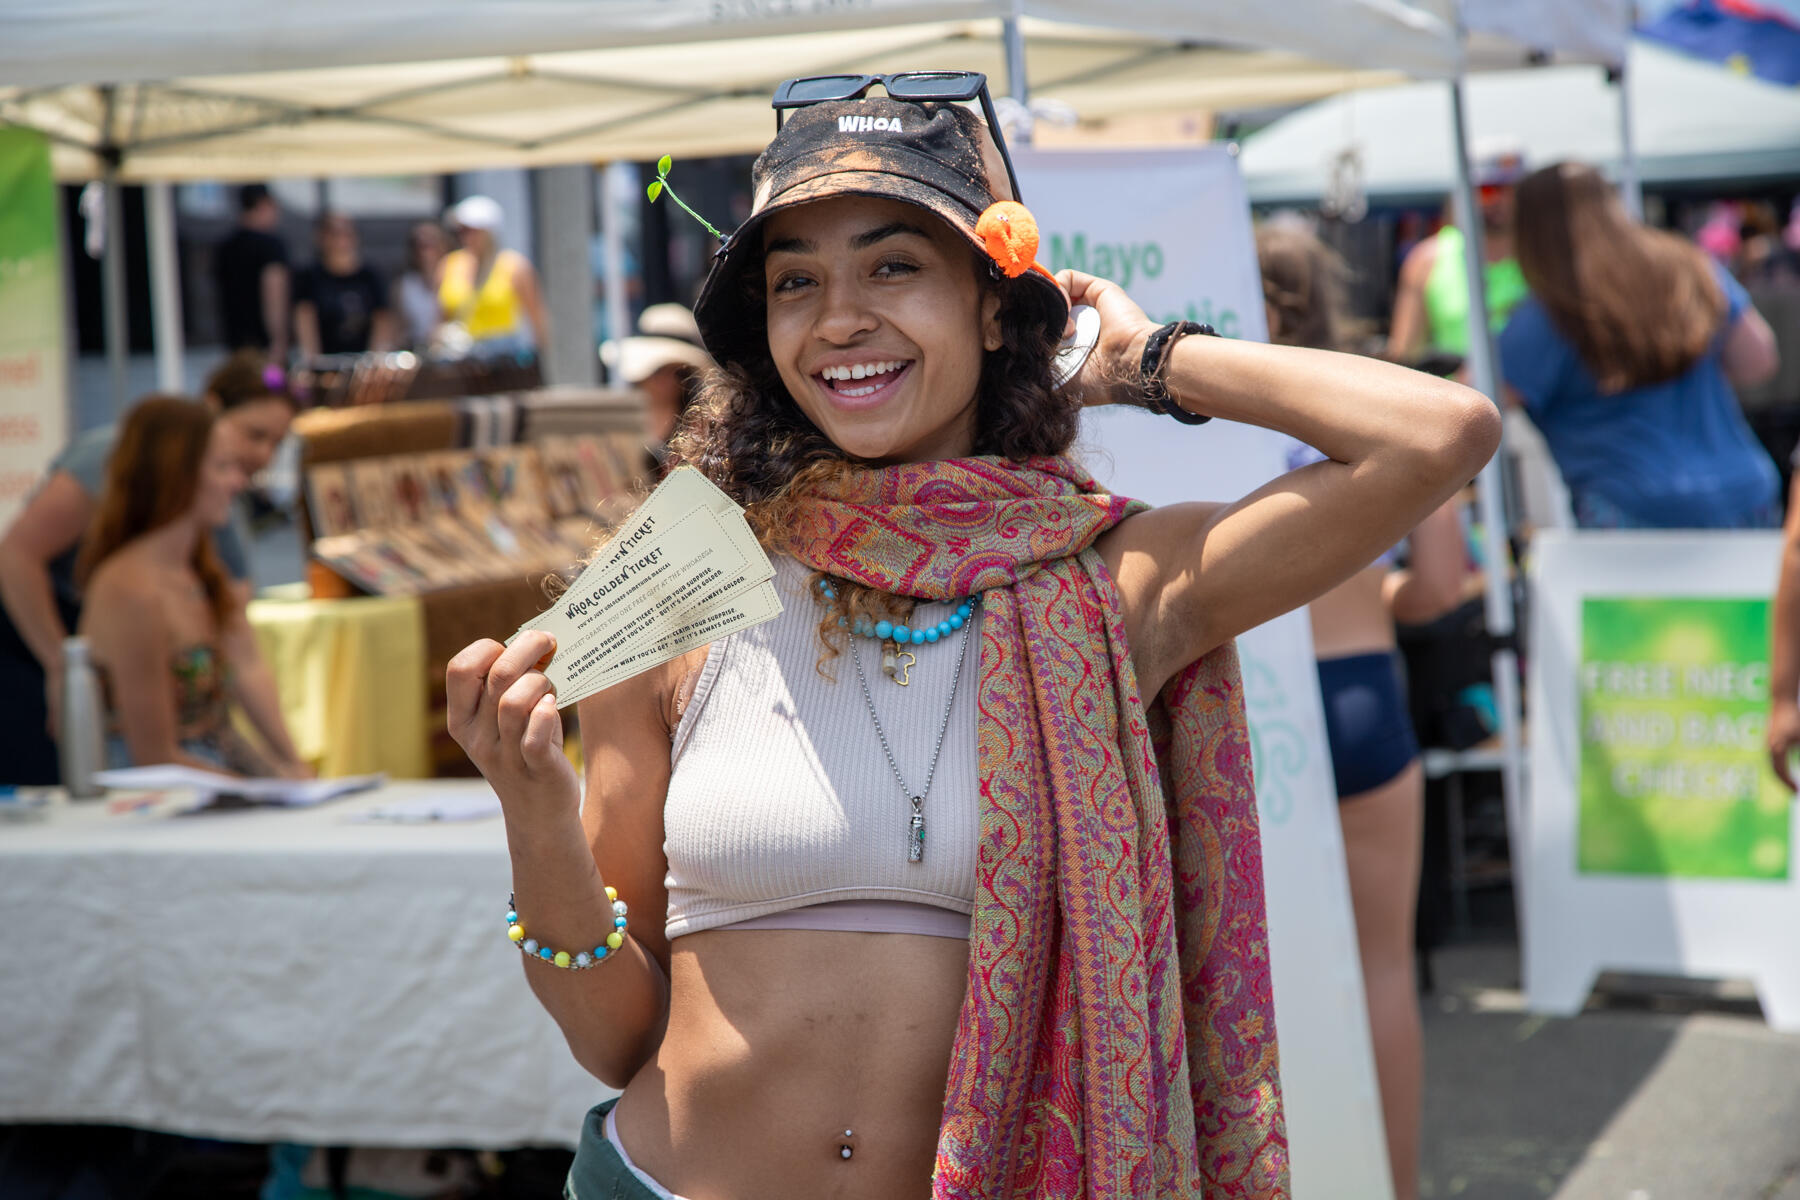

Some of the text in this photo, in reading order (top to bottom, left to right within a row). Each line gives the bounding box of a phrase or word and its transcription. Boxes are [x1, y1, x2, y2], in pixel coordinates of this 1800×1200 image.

[838, 115, 903, 133] WHOA
[1049, 233, 1164, 289] Mayo
[626, 516, 655, 547] TICKET
[565, 547, 662, 619] WHOA GOLDEN TICKET
[565, 638, 586, 655] TICKET
[585, 622, 608, 640] GRANTS
[608, 614, 620, 624] YOU
[619, 604, 633, 616] ONE
[632, 594, 647, 607] FREE
[646, 584, 661, 597] GIFT
[660, 578, 669, 587] AT
[668, 570, 681, 581] THE
[567, 672, 578, 682] YOU
[578, 659, 596, 674] NEVER
[595, 648, 612, 661] KNOW
[612, 637, 627, 649] WHAT
[627, 625, 645, 639] YOU'LL
[645, 617, 655, 626] GET
[659, 606, 670, 616] BUT
[670, 599, 680, 608] IT'S
[681, 584, 702, 600] ALWAYS
[568, 659, 581, 671] STEP
[600, 629, 624, 648] PRESENT
[624, 620, 637, 631] THIS
[655, 595, 672, 609] CLAIM
[672, 585, 686, 597] YOUR
[673, 626, 690, 636] CLAIM
[692, 619, 706, 628] YOUR
[620, 656, 636, 666] WHAT
[637, 648, 656, 659] YOU'LL
[674, 636, 685, 644] BUT
[687, 631, 697, 639] IT'S
[699, 622, 721, 634] ALWAYS
[1585, 661, 1771, 701] FREE NEC
[1586, 711, 1769, 751] AND BAC
